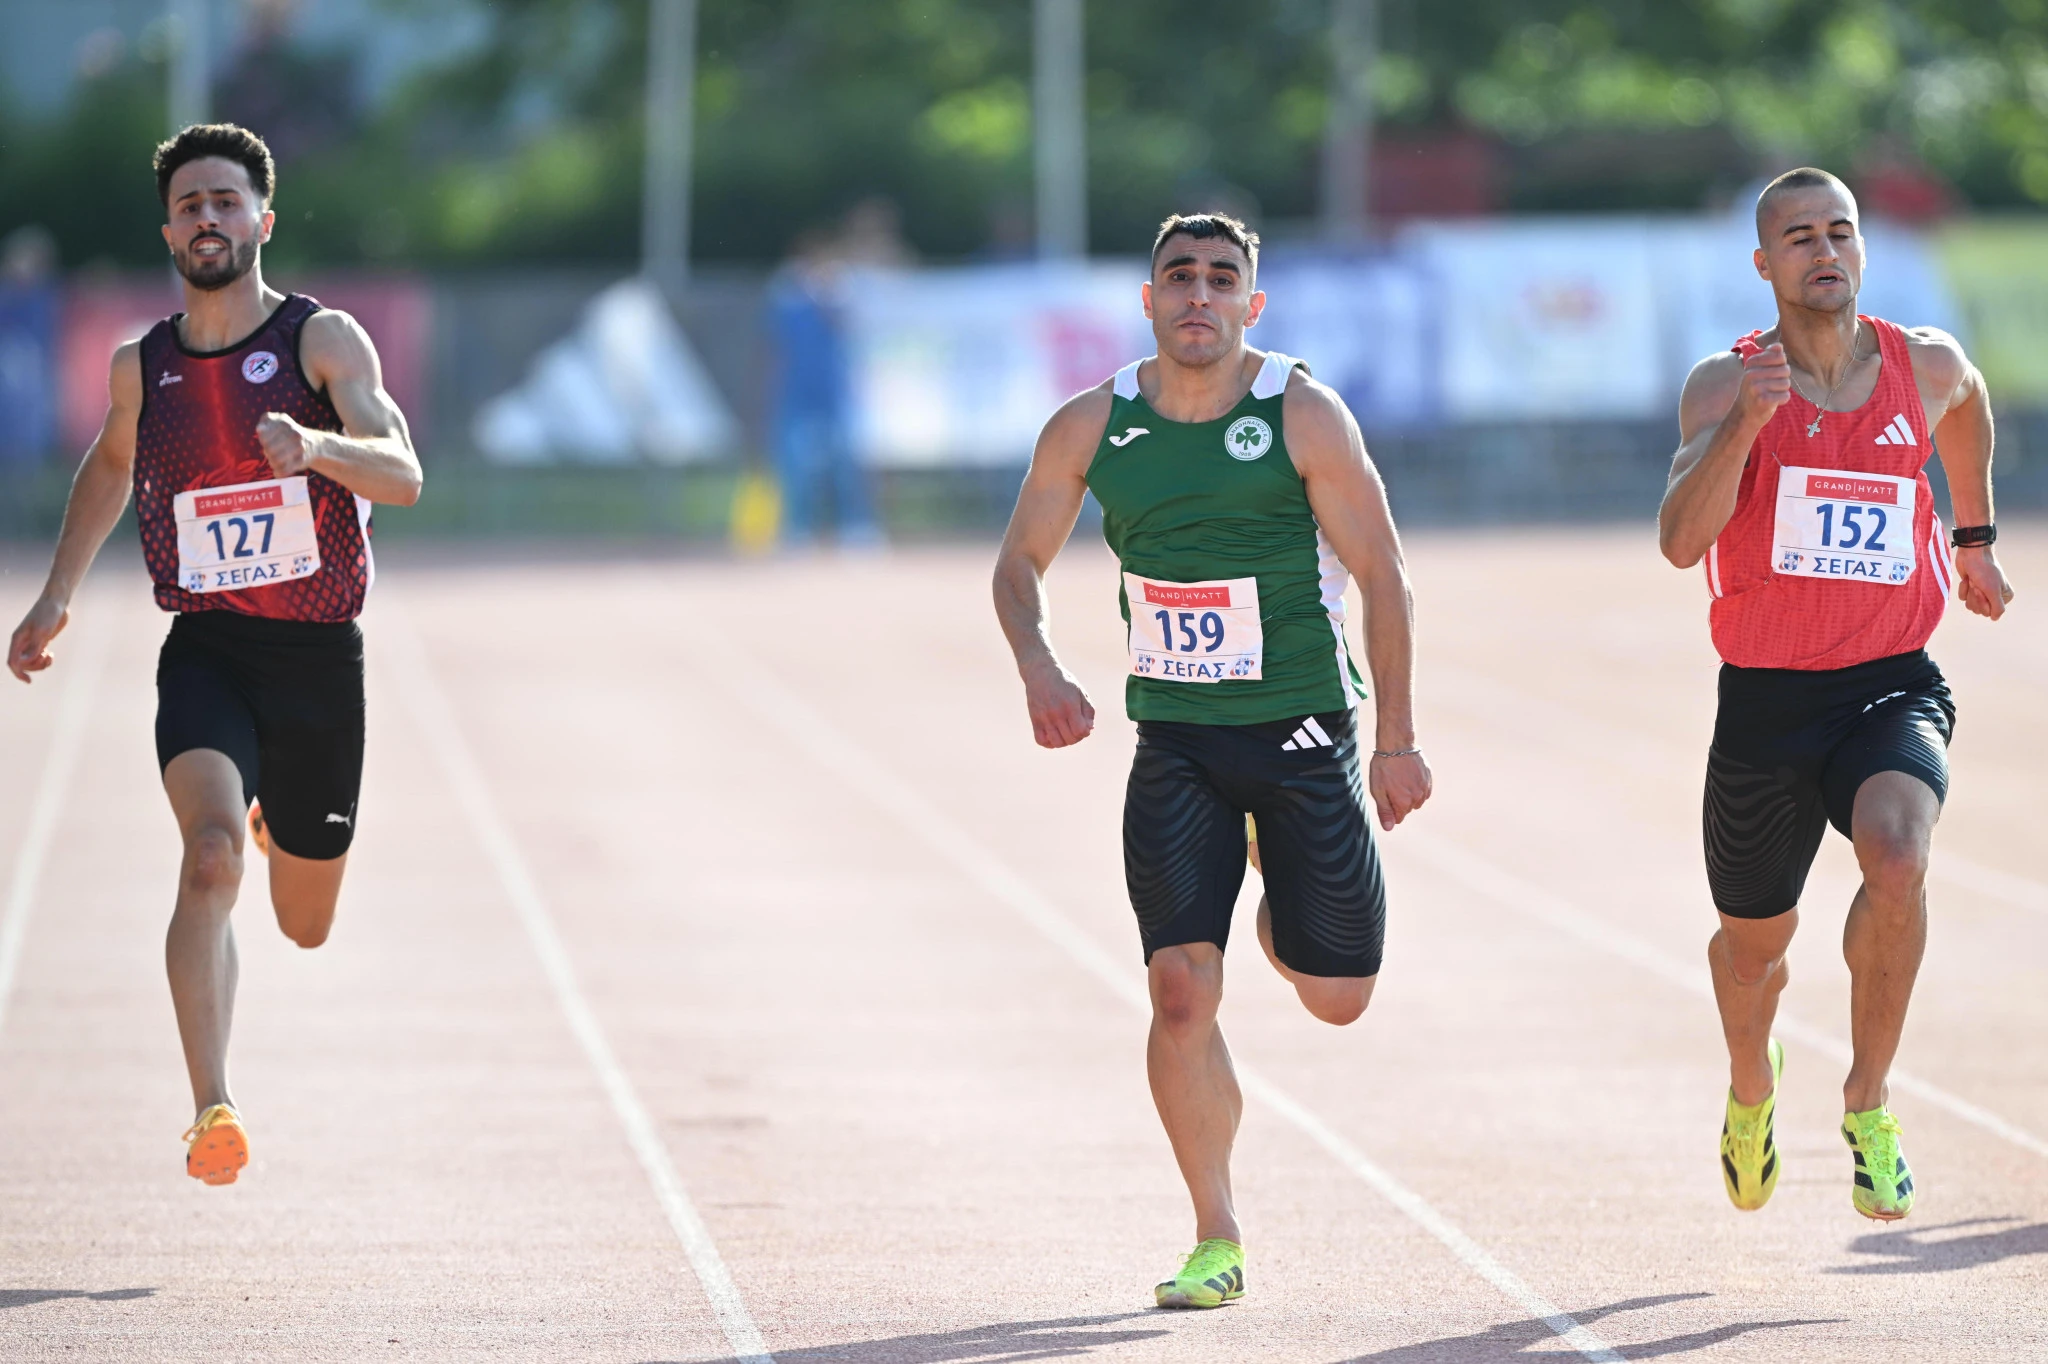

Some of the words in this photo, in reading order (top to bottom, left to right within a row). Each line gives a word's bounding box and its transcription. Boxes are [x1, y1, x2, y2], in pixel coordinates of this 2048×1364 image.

[1814, 480, 1852, 492] GRAND
[1858, 485, 1894, 496] HYATT
[199, 496, 233, 510] GRAND
[238, 491, 275, 504] HYATT
[207, 513, 275, 561] 127
[1816, 503, 1887, 552] 152
[215, 562, 282, 587] ΣΕΓΑΣ
[1812, 556, 1882, 578] ΣΕΓΑΣ
[1149, 588, 1180, 600] GRAND
[1186, 591, 1222, 600] HYATT
[1155, 609, 1225, 653] 159
[1162, 659, 1226, 679] ΣΕΓΑΣ
